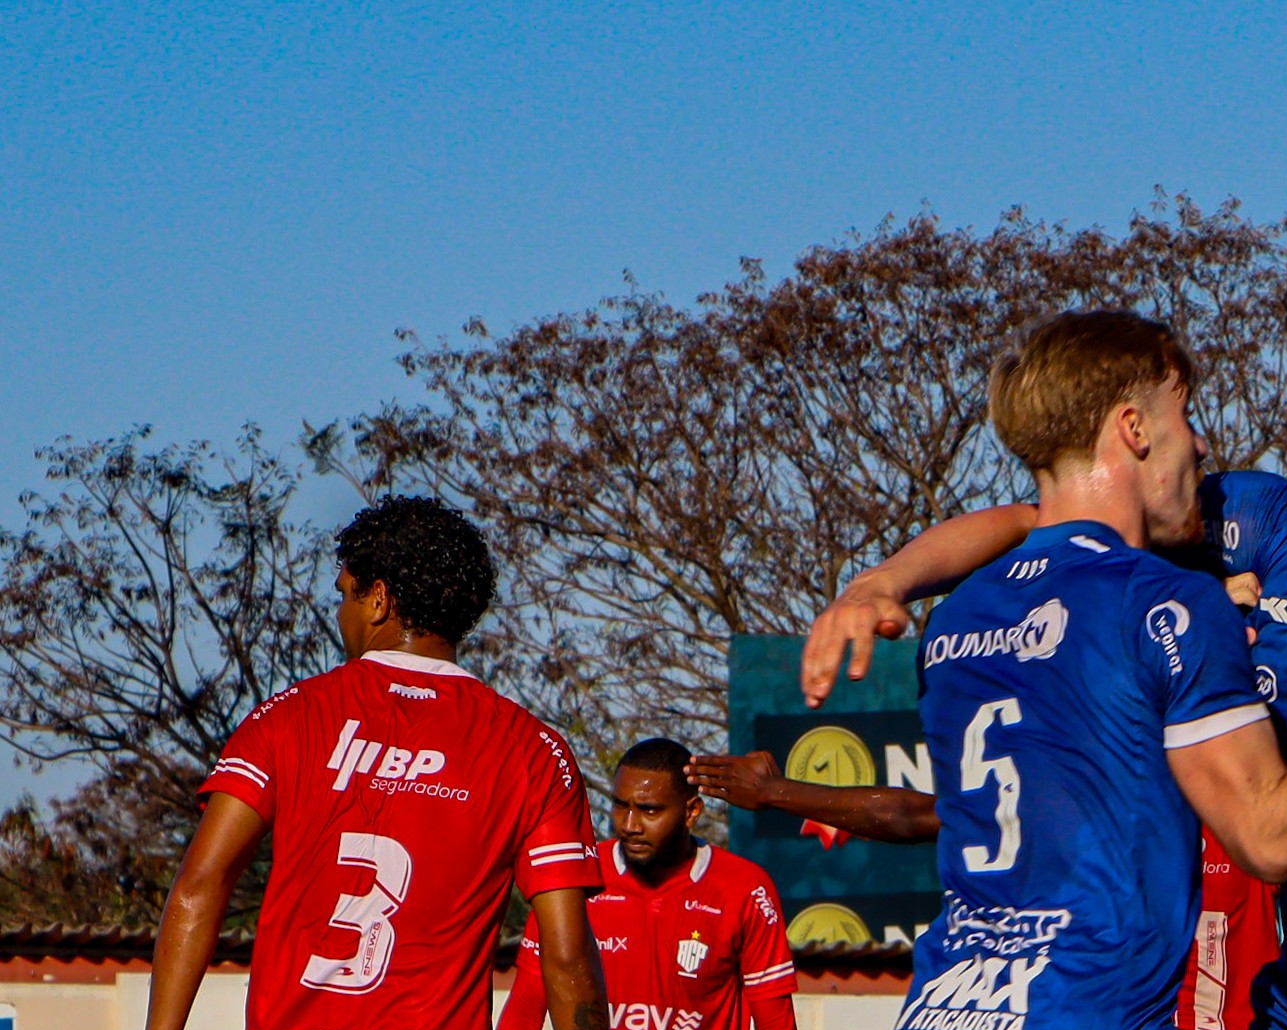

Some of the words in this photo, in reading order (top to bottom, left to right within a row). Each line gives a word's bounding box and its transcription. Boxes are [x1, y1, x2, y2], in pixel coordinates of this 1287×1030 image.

[369, 777, 470, 802] seguradora
[376, 746, 447, 780] BP
[960, 697, 1022, 873] 5
[300, 831, 412, 994] 3
[897, 953, 1051, 1030] MAX
